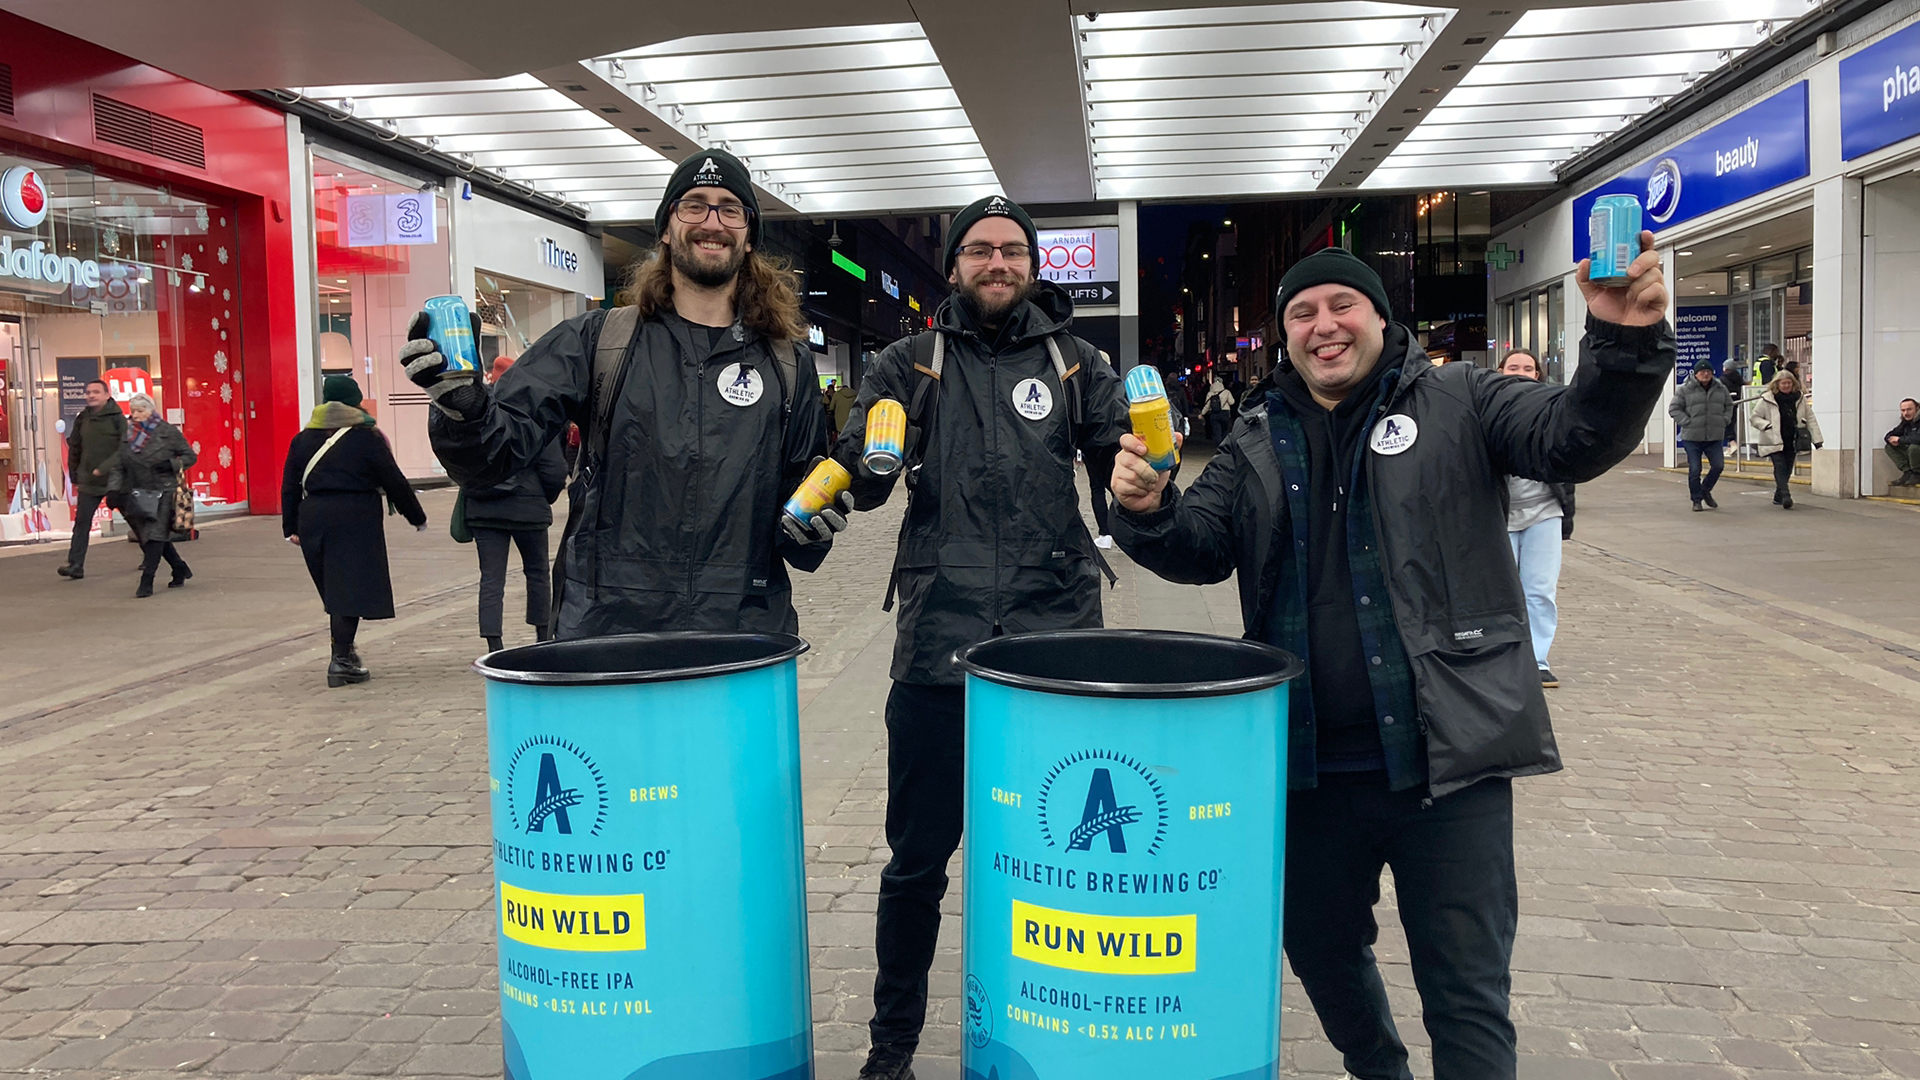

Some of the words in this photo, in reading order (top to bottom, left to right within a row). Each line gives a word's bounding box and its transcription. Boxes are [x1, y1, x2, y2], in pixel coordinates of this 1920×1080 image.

[1883, 65, 1920, 112] pha
[1716, 136, 1759, 177] beauty
[693, 173, 723, 182] ATHLETIC
[543, 237, 578, 272] Three
[1038, 232, 1095, 270] ood
[1053, 236, 1090, 244] ARNDALE
[1039, 270, 1096, 281] URT
[1069, 289, 1098, 299] LIFTS
[1676, 313, 1717, 323] welcome
[724, 386, 755, 399] ATHLETIC
[1020, 403, 1046, 411] ATHLETIC
[1377, 435, 1409, 447] ATHLETIC
[629, 785, 678, 803] BREWS
[991, 786, 1022, 808] CRAFT
[1189, 802, 1232, 820] BREWS
[493, 837, 535, 870] THLETIC
[542, 851, 633, 874] BREWING
[993, 851, 1076, 889] ATHLETIC
[1087, 870, 1189, 894] BREWING
[506, 898, 544, 931] RUN
[552, 910, 630, 935] WILD
[1025, 918, 1085, 954] RUN
[1096, 931, 1183, 958] WILD
[508, 957, 599, 990] ALCOHOL-FREE
[606, 972, 634, 990] IPA
[503, 980, 539, 1008] CONTAINS
[581, 1001, 607, 1016] ALC
[625, 999, 652, 1015] VOL
[1020, 980, 1147, 1014] ALCOHOL-FREE
[1155, 995, 1182, 1014] IPA
[1007, 1004, 1070, 1035] CONTAINS
[1125, 1025, 1154, 1041] ALC
[1171, 1022, 1198, 1038] VOL
